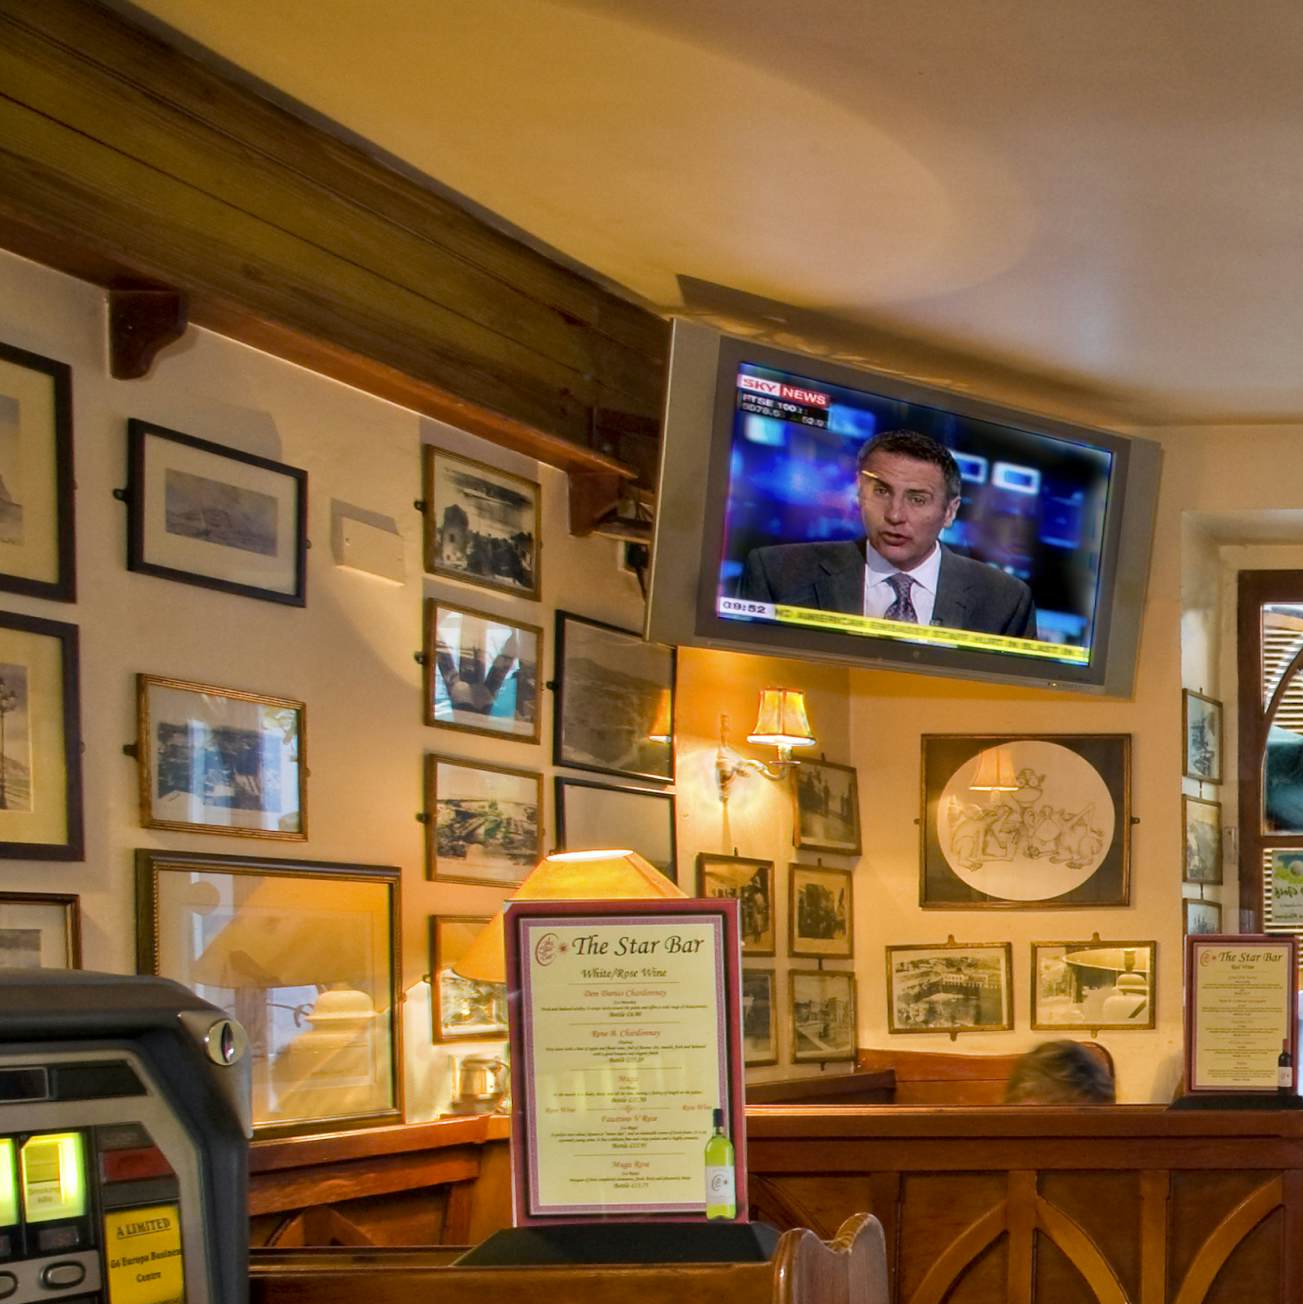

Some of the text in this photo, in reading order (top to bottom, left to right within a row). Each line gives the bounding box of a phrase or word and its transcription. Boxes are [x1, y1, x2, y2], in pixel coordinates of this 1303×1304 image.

[743, 378, 826, 405] SKY NEWS
[722, 600, 767, 614] 09:52
[572, 935, 704, 957] The Star Bar
[1218, 951, 1283, 963] The Star Bar
[642, 967, 667, 977] Wine
[116, 1217, 171, 1237] A LIMITED
